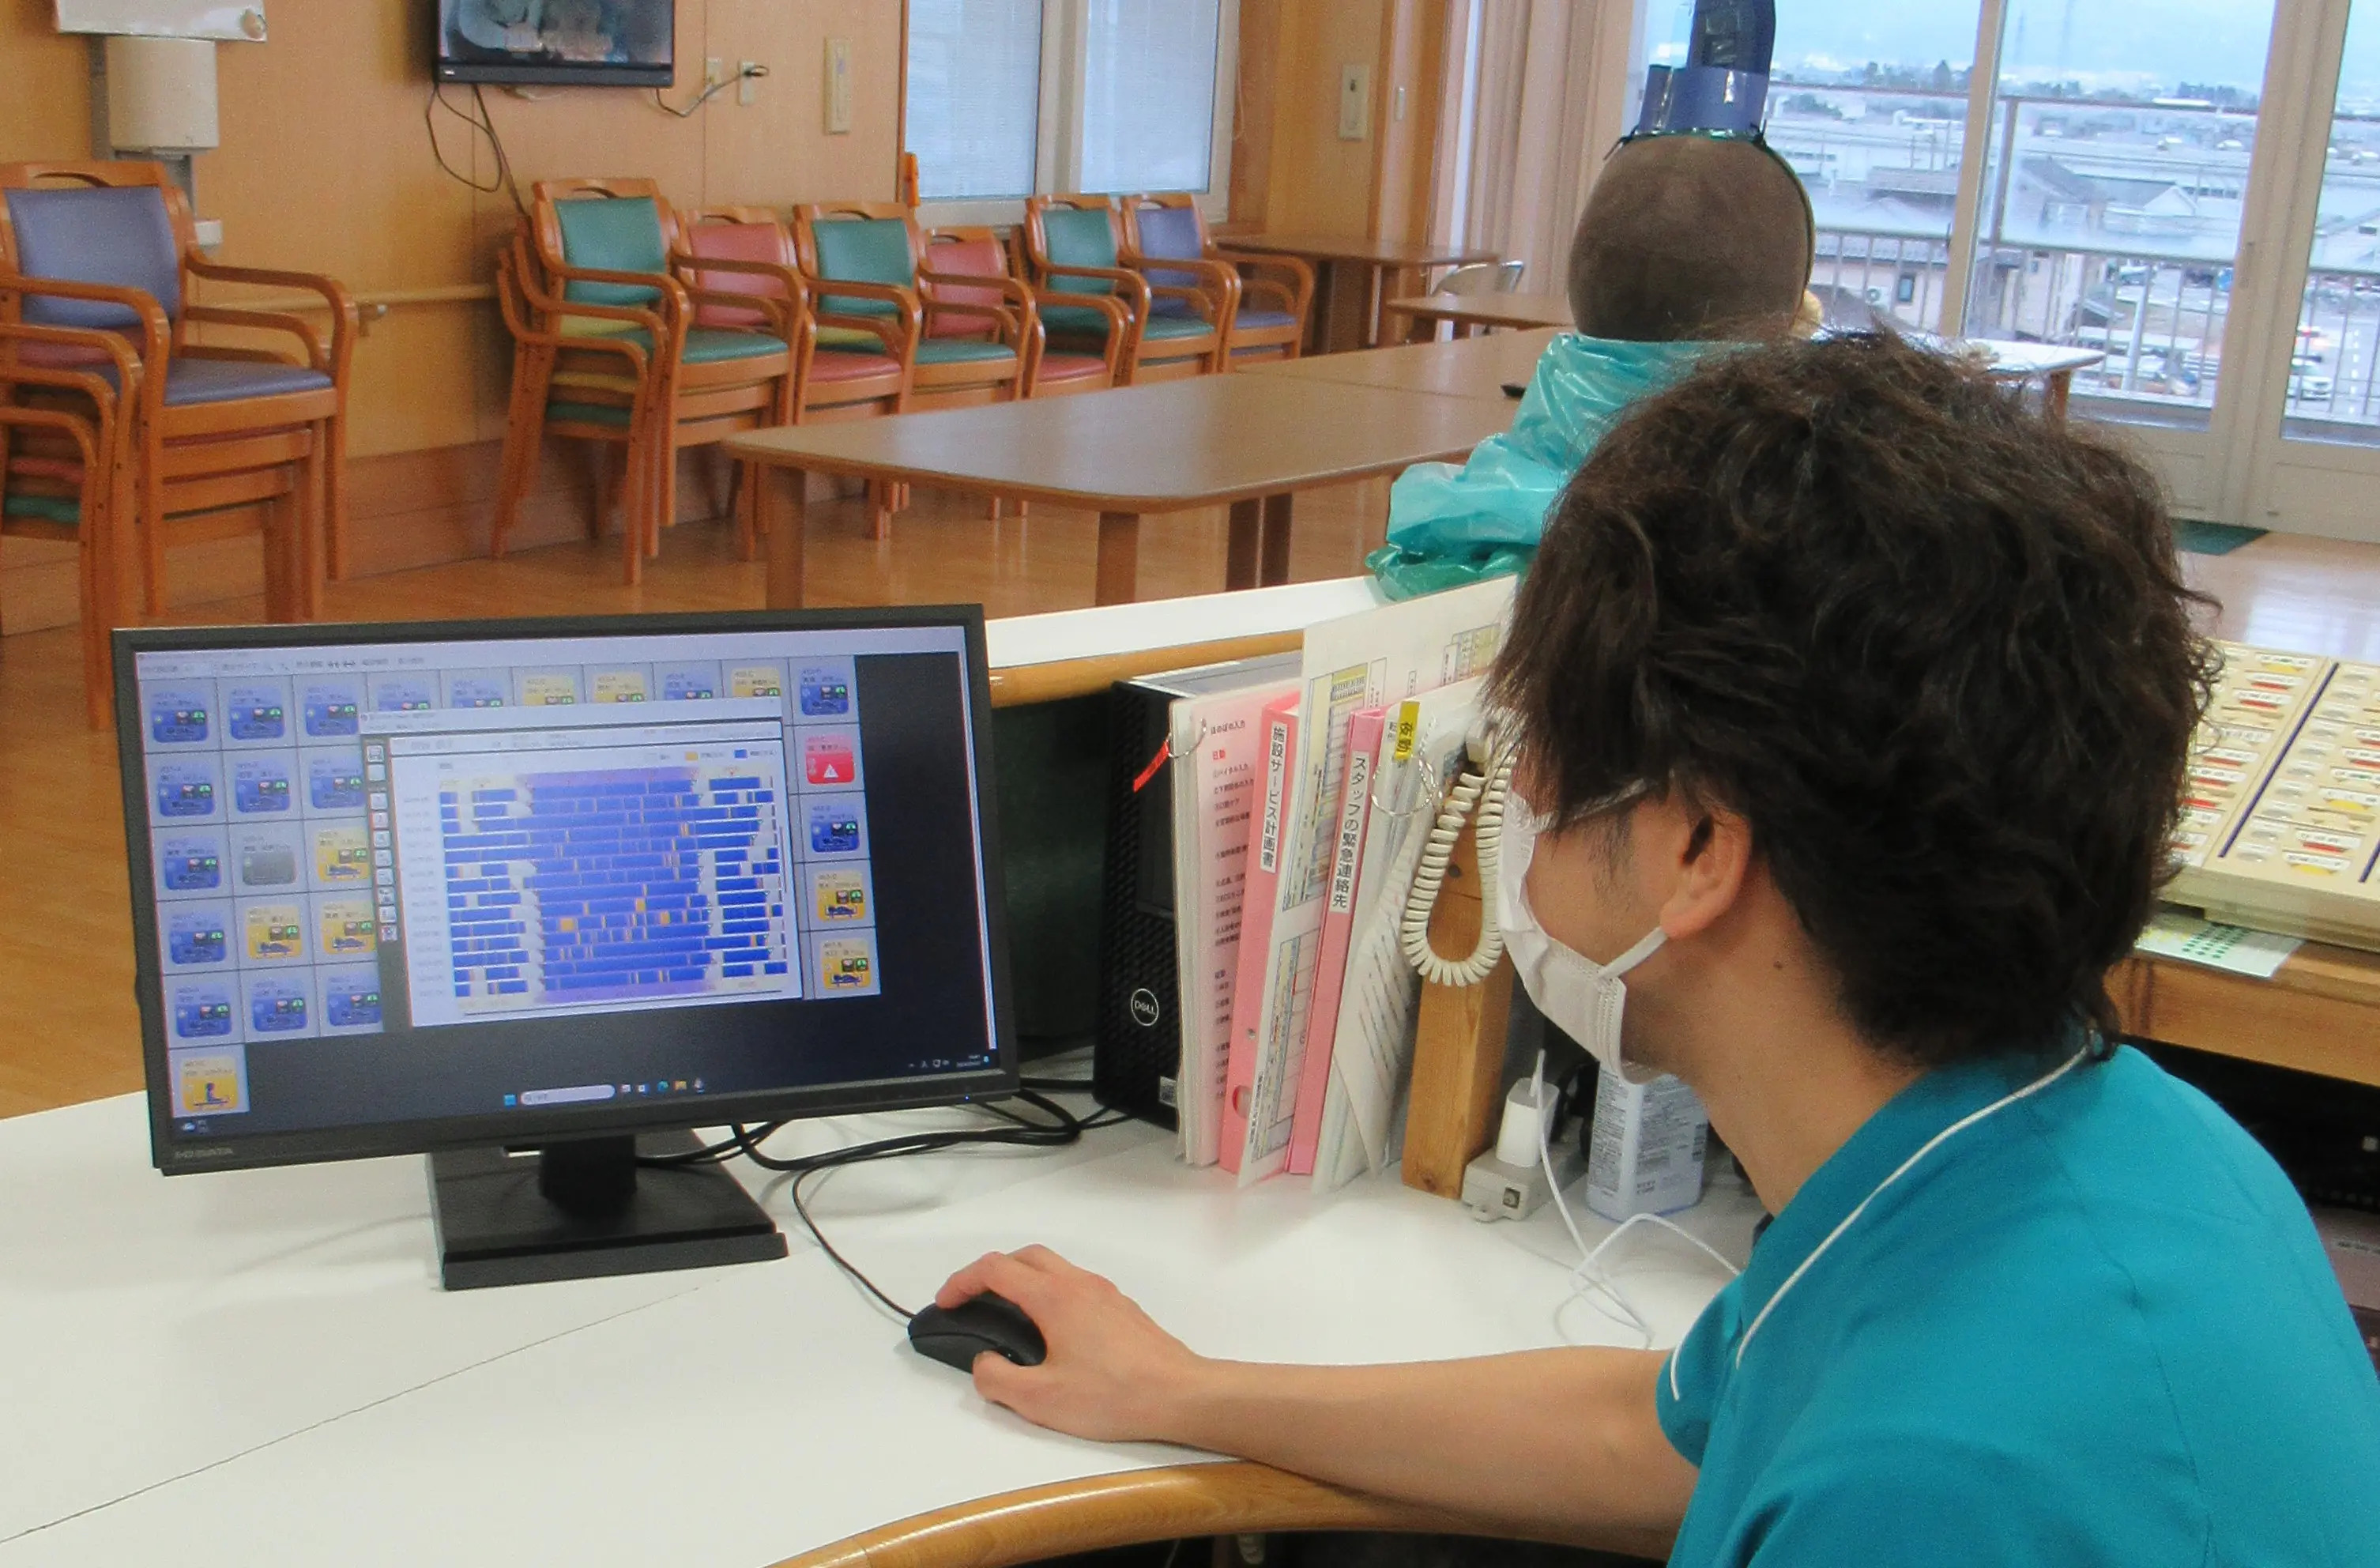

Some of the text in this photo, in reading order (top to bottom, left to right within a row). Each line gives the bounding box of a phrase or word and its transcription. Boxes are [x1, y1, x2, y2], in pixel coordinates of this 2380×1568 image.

[1263, 726, 1286, 867] 施設サービス計画書
[1332, 756, 1367, 909] スタッフの緊急連絡先
